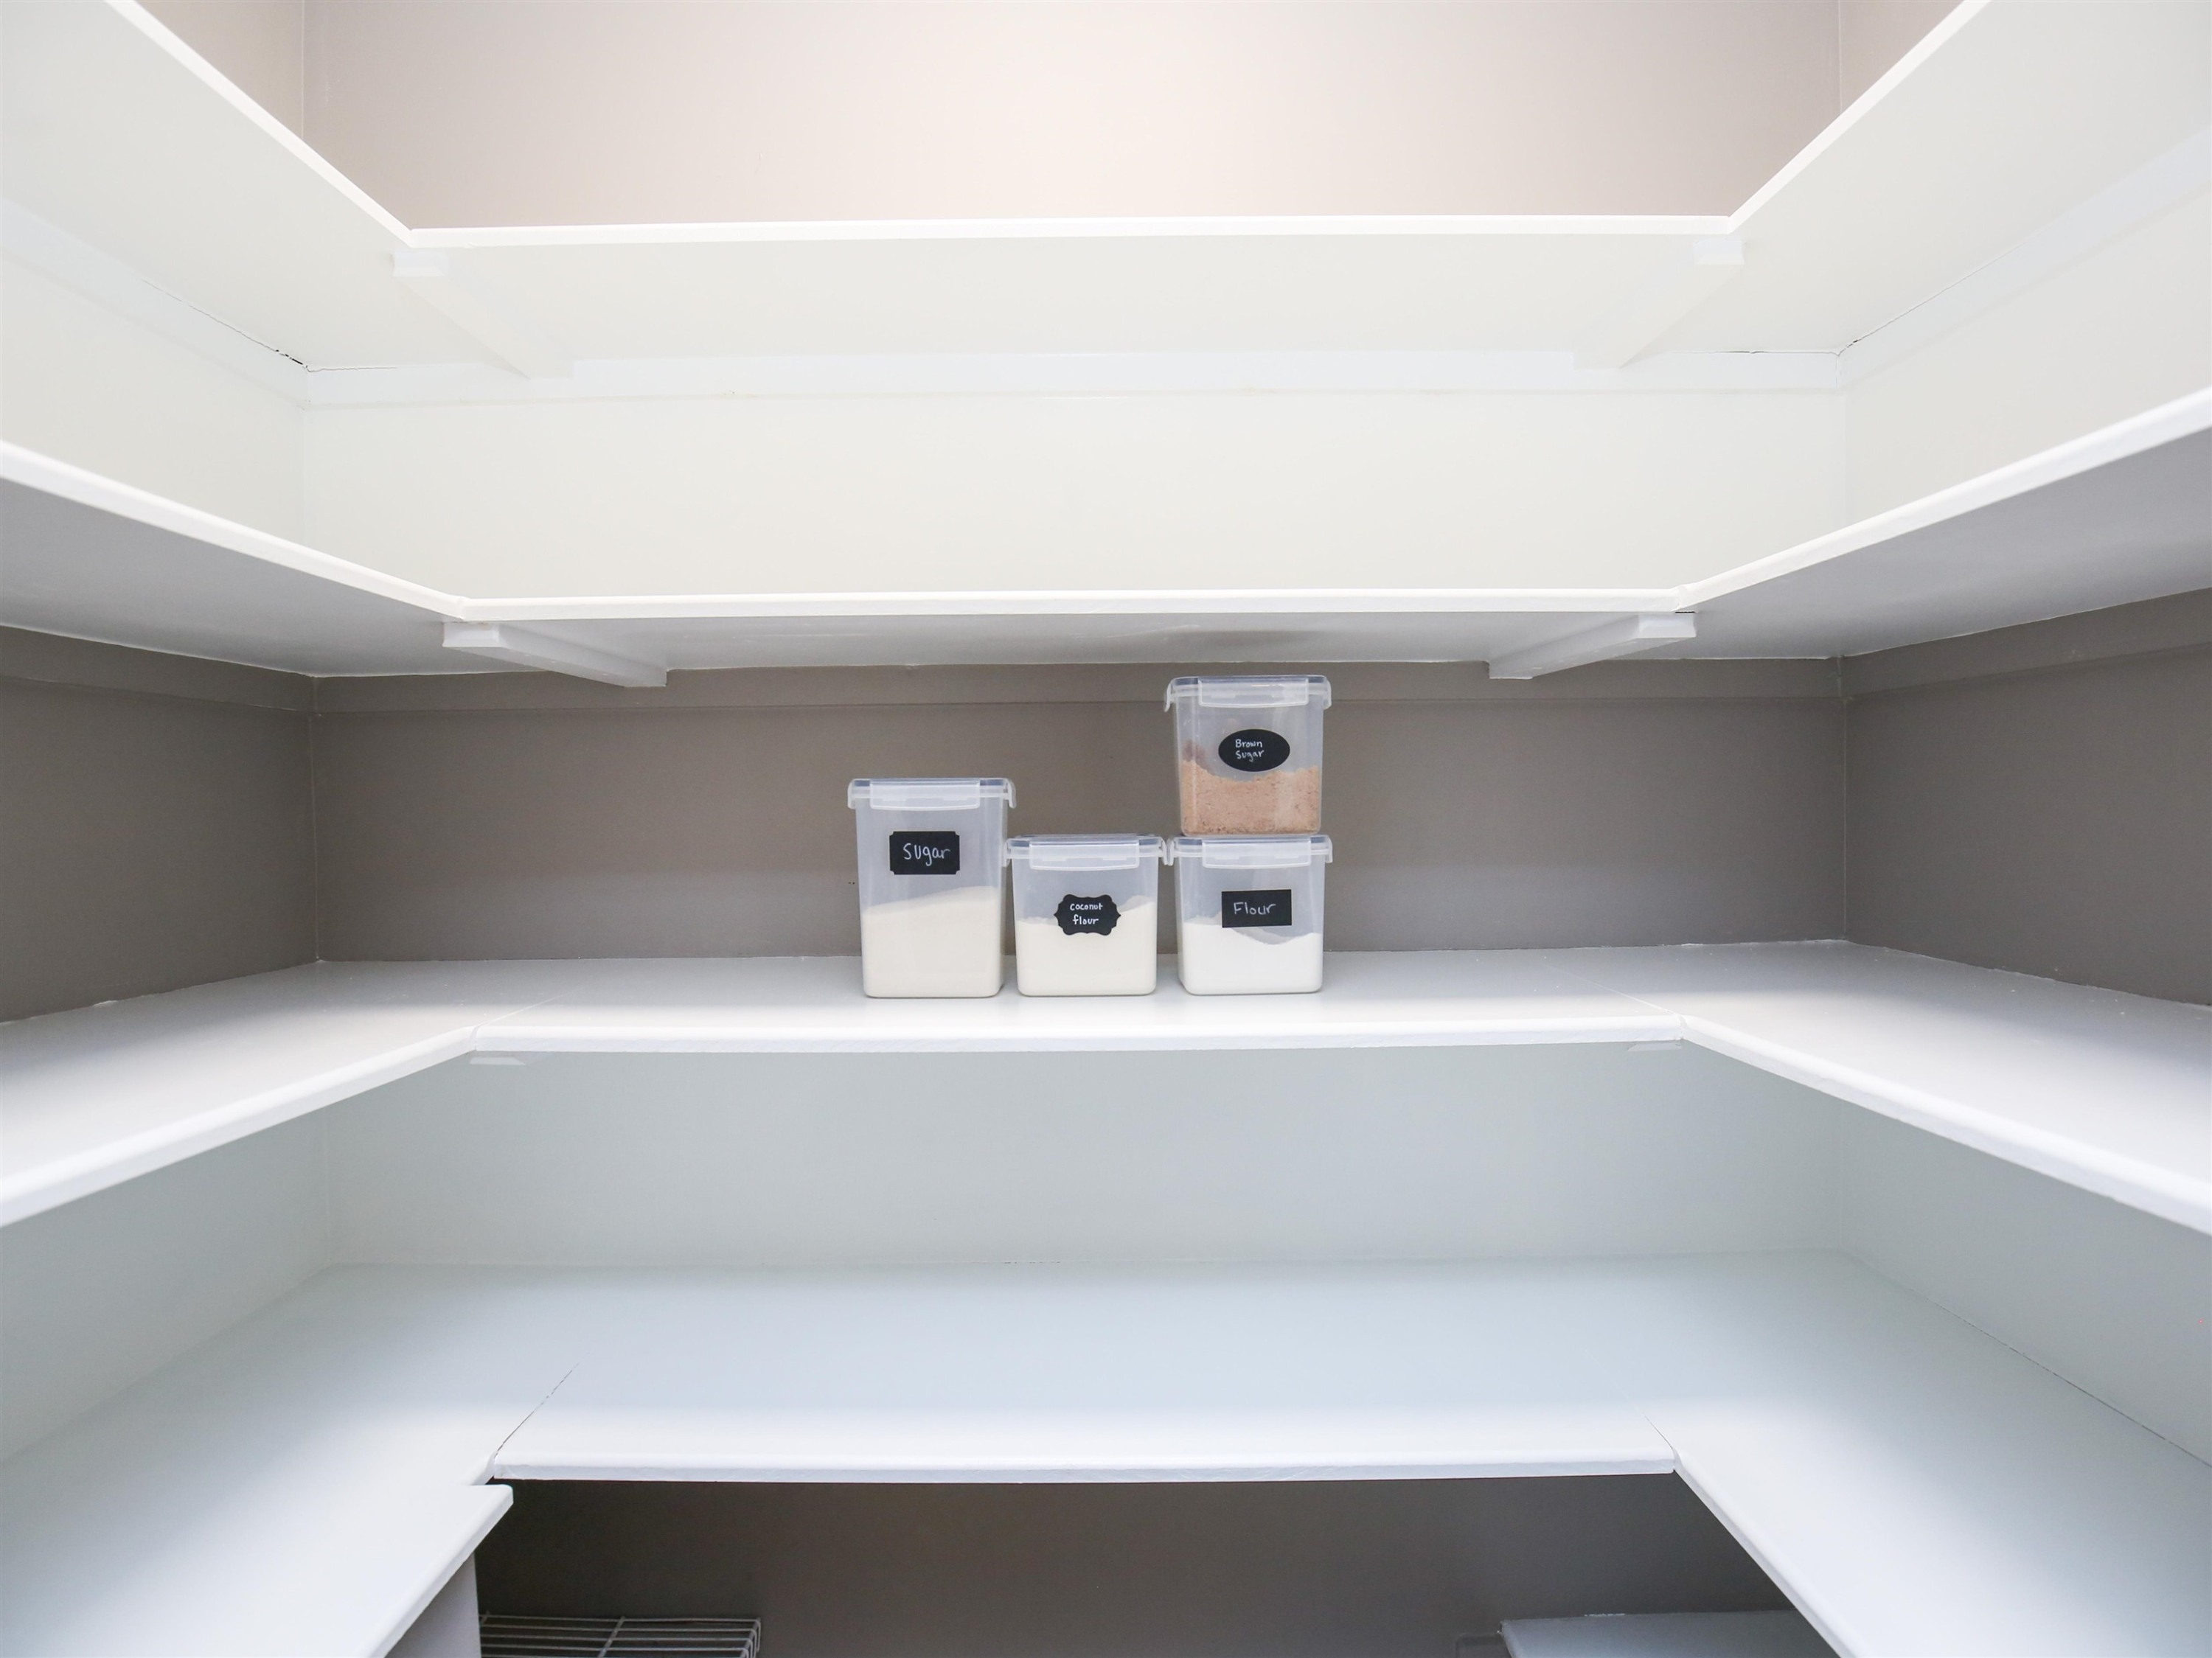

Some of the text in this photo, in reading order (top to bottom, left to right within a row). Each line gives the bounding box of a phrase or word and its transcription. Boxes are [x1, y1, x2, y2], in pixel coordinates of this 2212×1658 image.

[1235, 739, 1263, 748] Brown
[1235, 750, 1265, 762] Sugar
[902, 843, 950, 866] Sugar
[1234, 902, 1276, 915] Flour
[1072, 913, 1099, 925] flour
